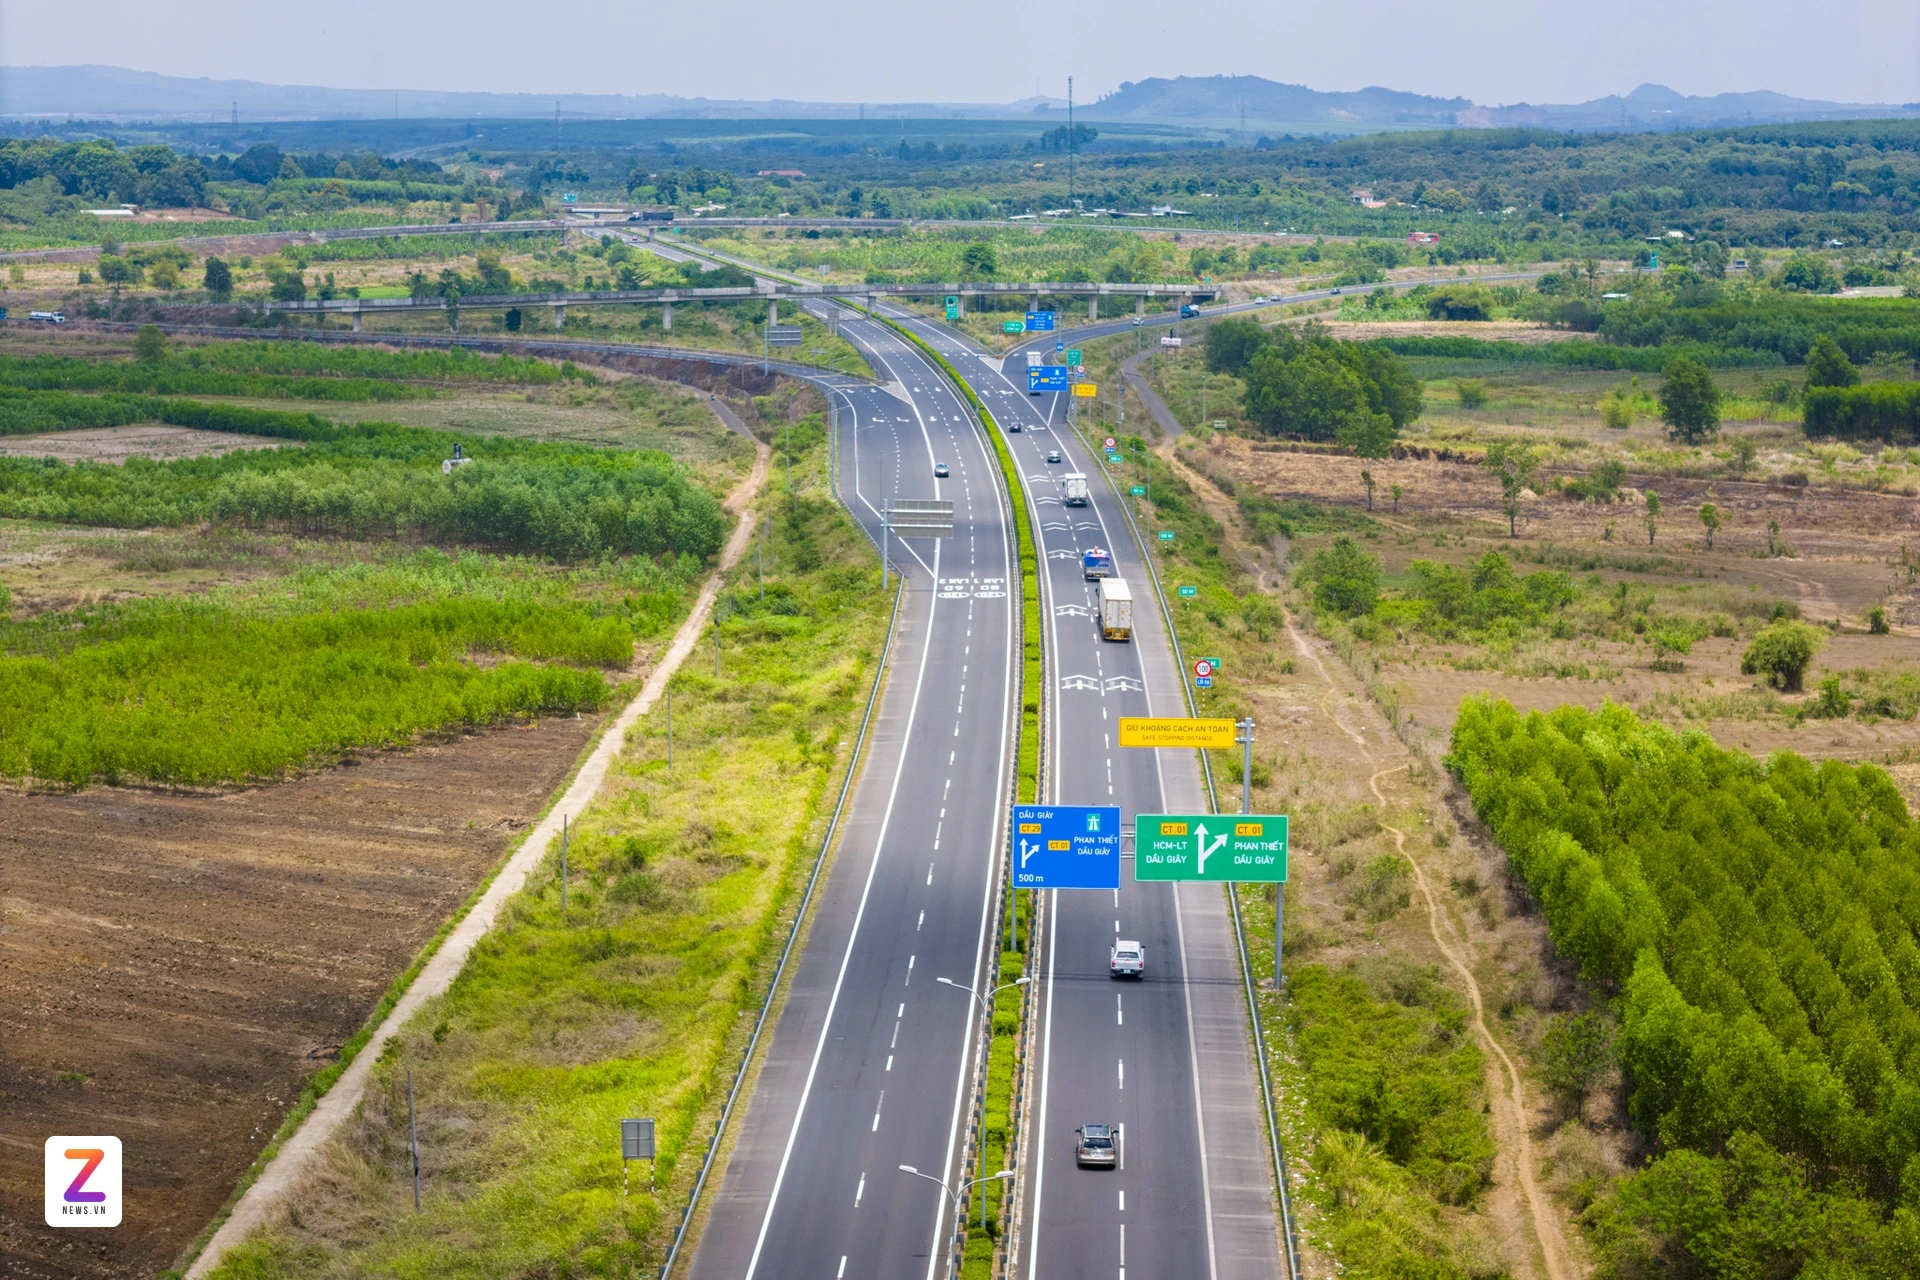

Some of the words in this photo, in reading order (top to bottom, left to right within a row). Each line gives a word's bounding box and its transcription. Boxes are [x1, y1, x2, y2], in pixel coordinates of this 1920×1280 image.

[1098, 834, 1118, 844] THIẾT
[1154, 841, 1187, 849] HCM-LT
[1234, 842, 1258, 850] PHAN
[1260, 840, 1284, 850] THIẾT
[1166, 854, 1187, 863] GIÂY
[1018, 874, 1034, 882] 500
